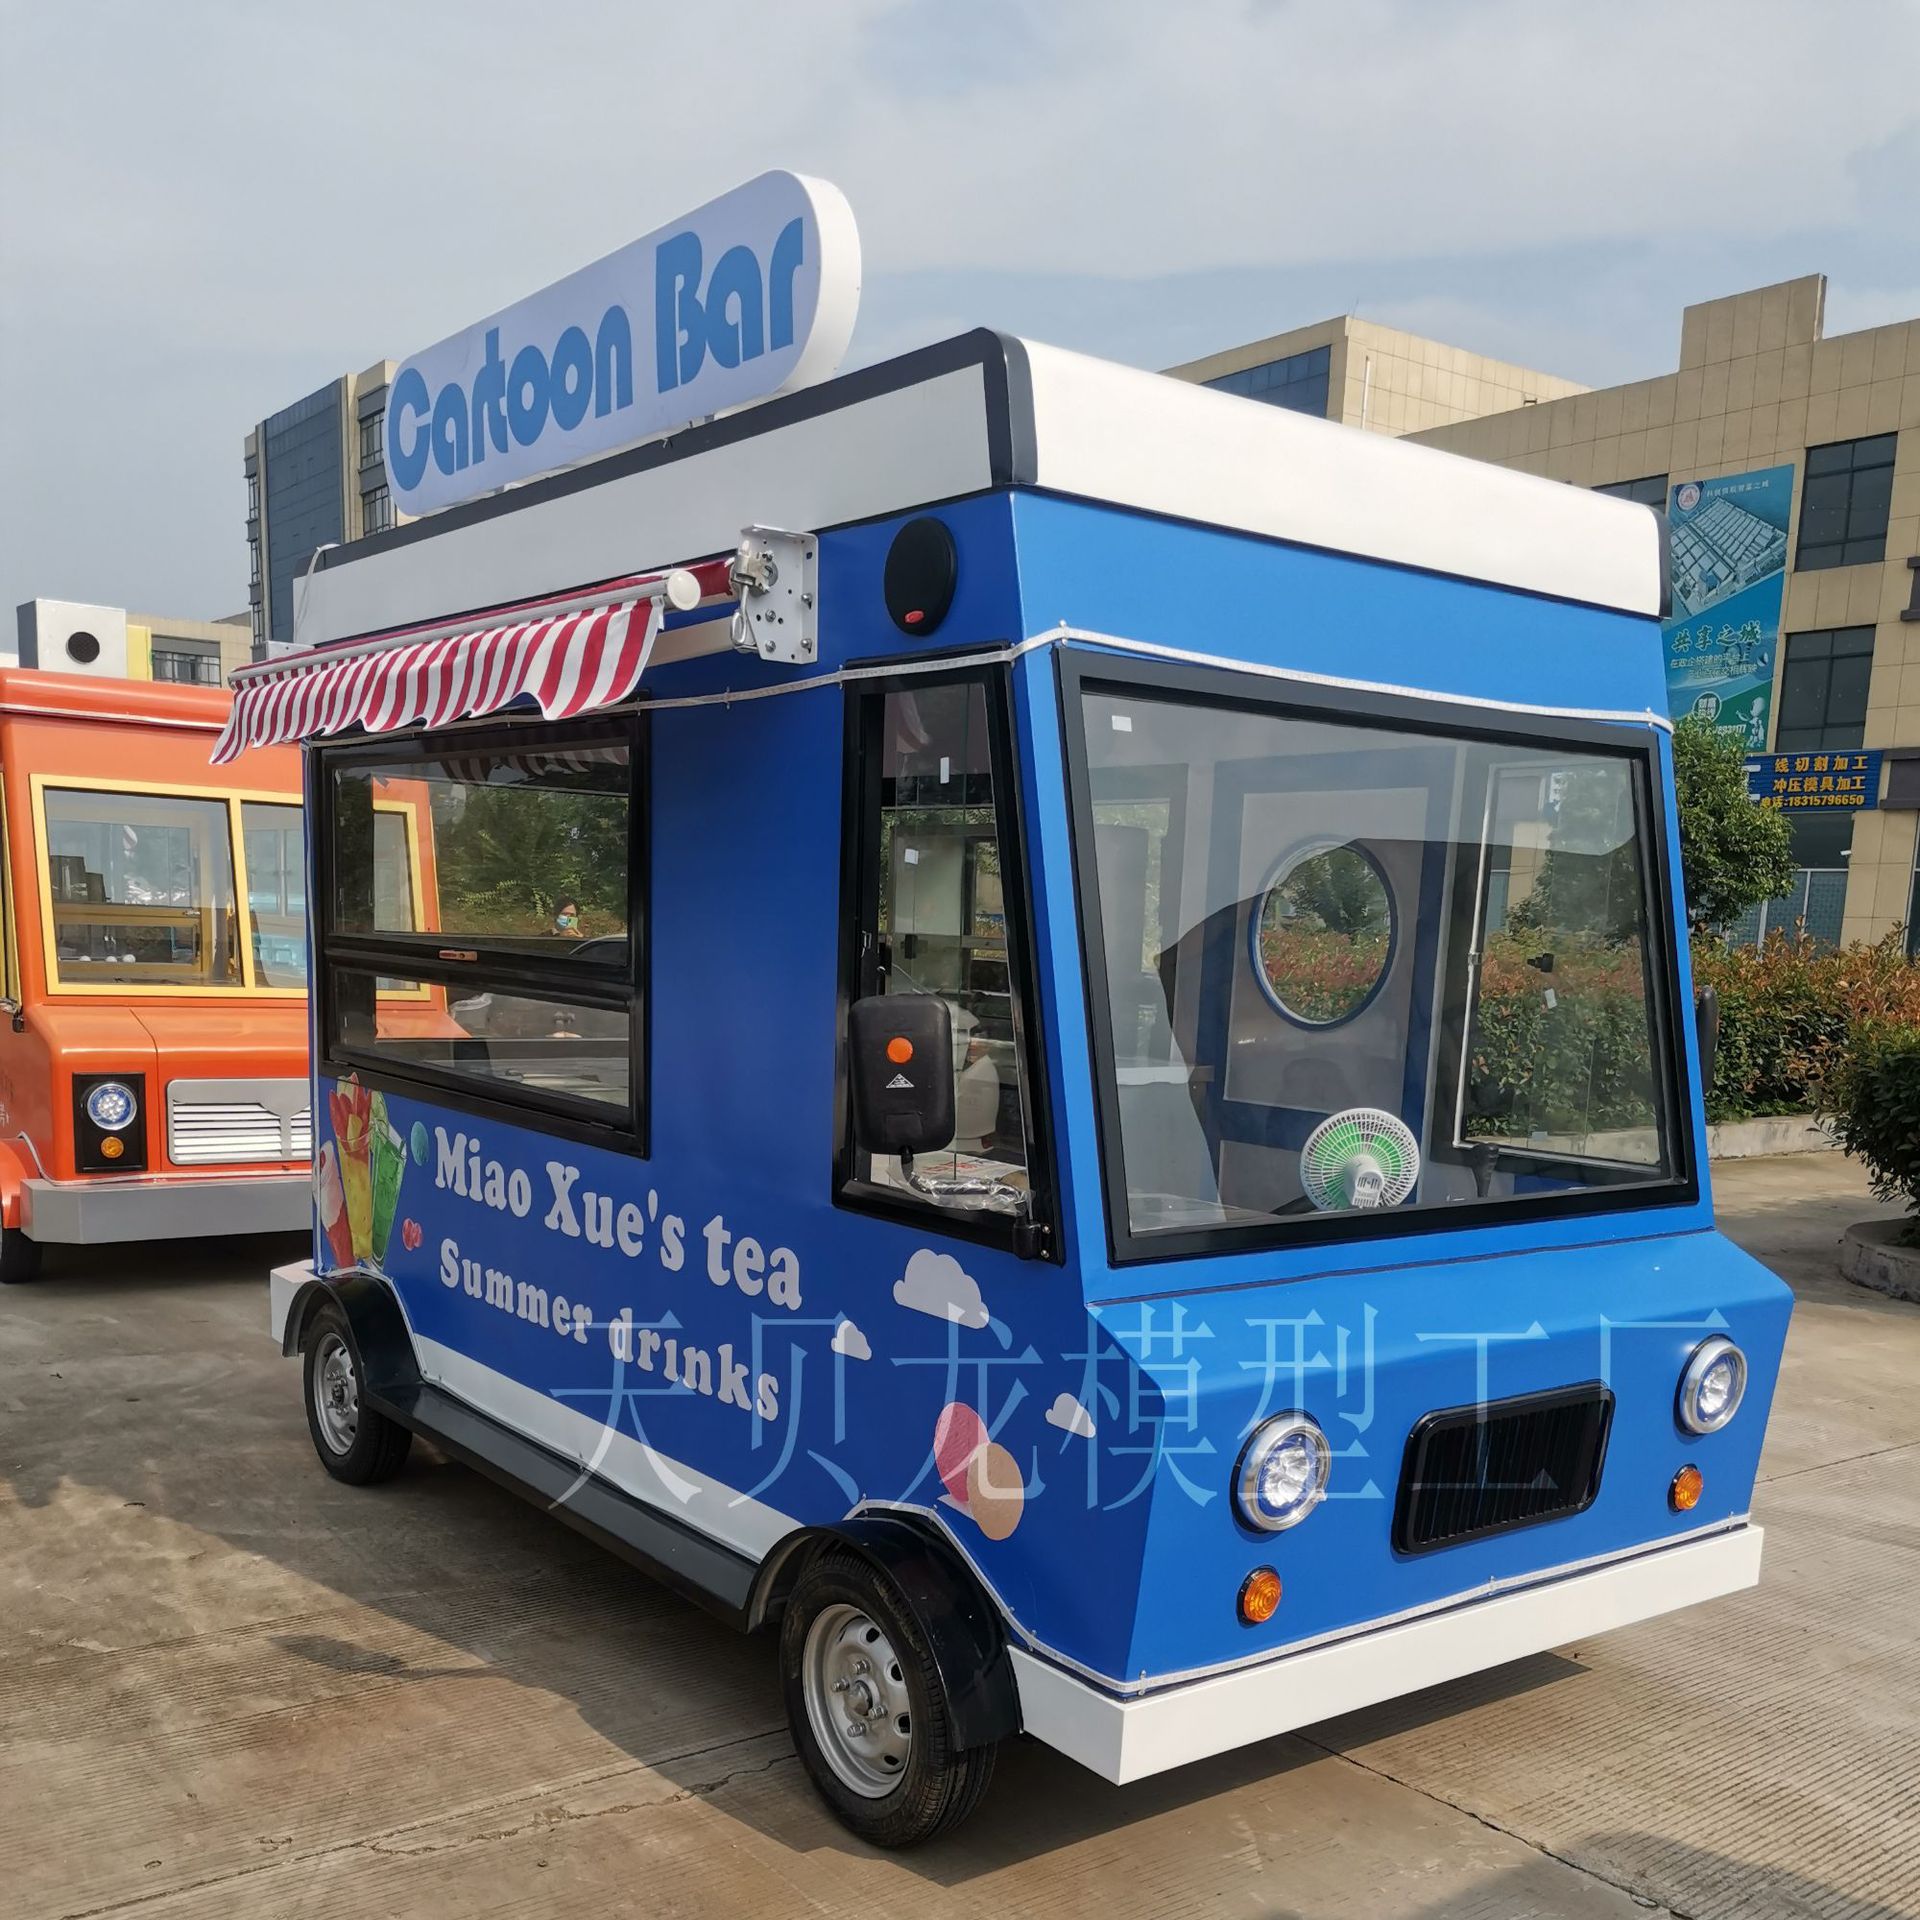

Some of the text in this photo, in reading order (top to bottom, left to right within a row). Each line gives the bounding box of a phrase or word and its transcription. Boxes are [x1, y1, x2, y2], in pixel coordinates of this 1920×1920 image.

[388, 216, 804, 492] Cartoon Bar
[1671, 620, 1761, 653] 共享之城
[1773, 776, 1866, 793] 冲压模具加工
[1774, 755, 1868, 772] 线切割加工
[434, 1127, 802, 1310] Miao Xue's tea
[439, 1238, 780, 1421] Summer drinks
